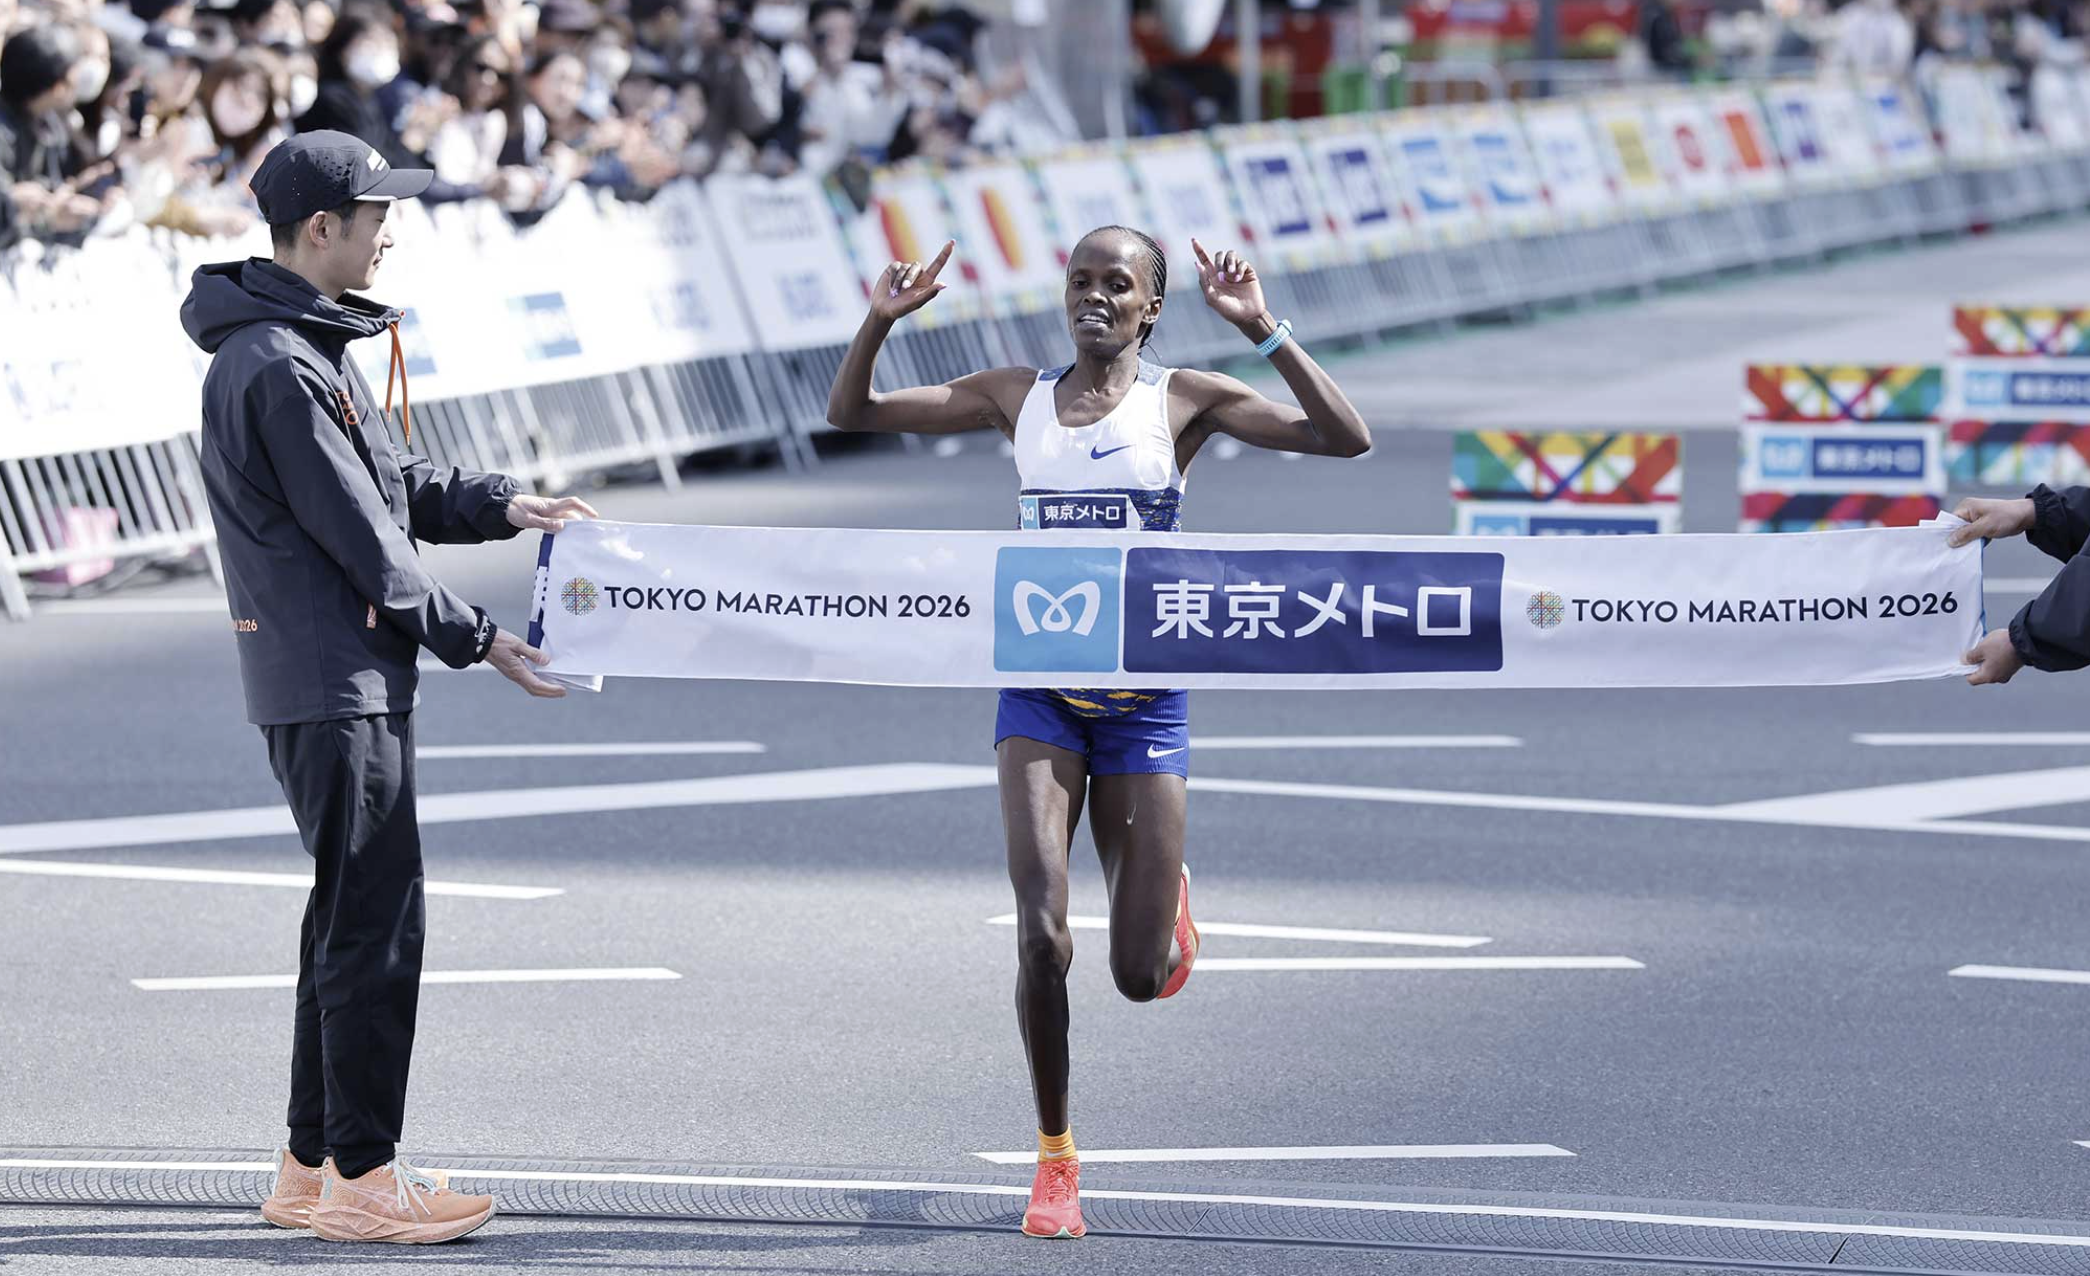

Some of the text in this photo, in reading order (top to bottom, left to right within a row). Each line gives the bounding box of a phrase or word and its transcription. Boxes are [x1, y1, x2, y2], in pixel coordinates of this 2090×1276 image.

[1043, 504, 1120, 521] 東京メトロ
[603, 586, 971, 618] TOKYO MARATHON 2026
[1151, 579, 1473, 640] 東京メトロ
[1571, 591, 1958, 623] TOKYO MARATHON 2026
